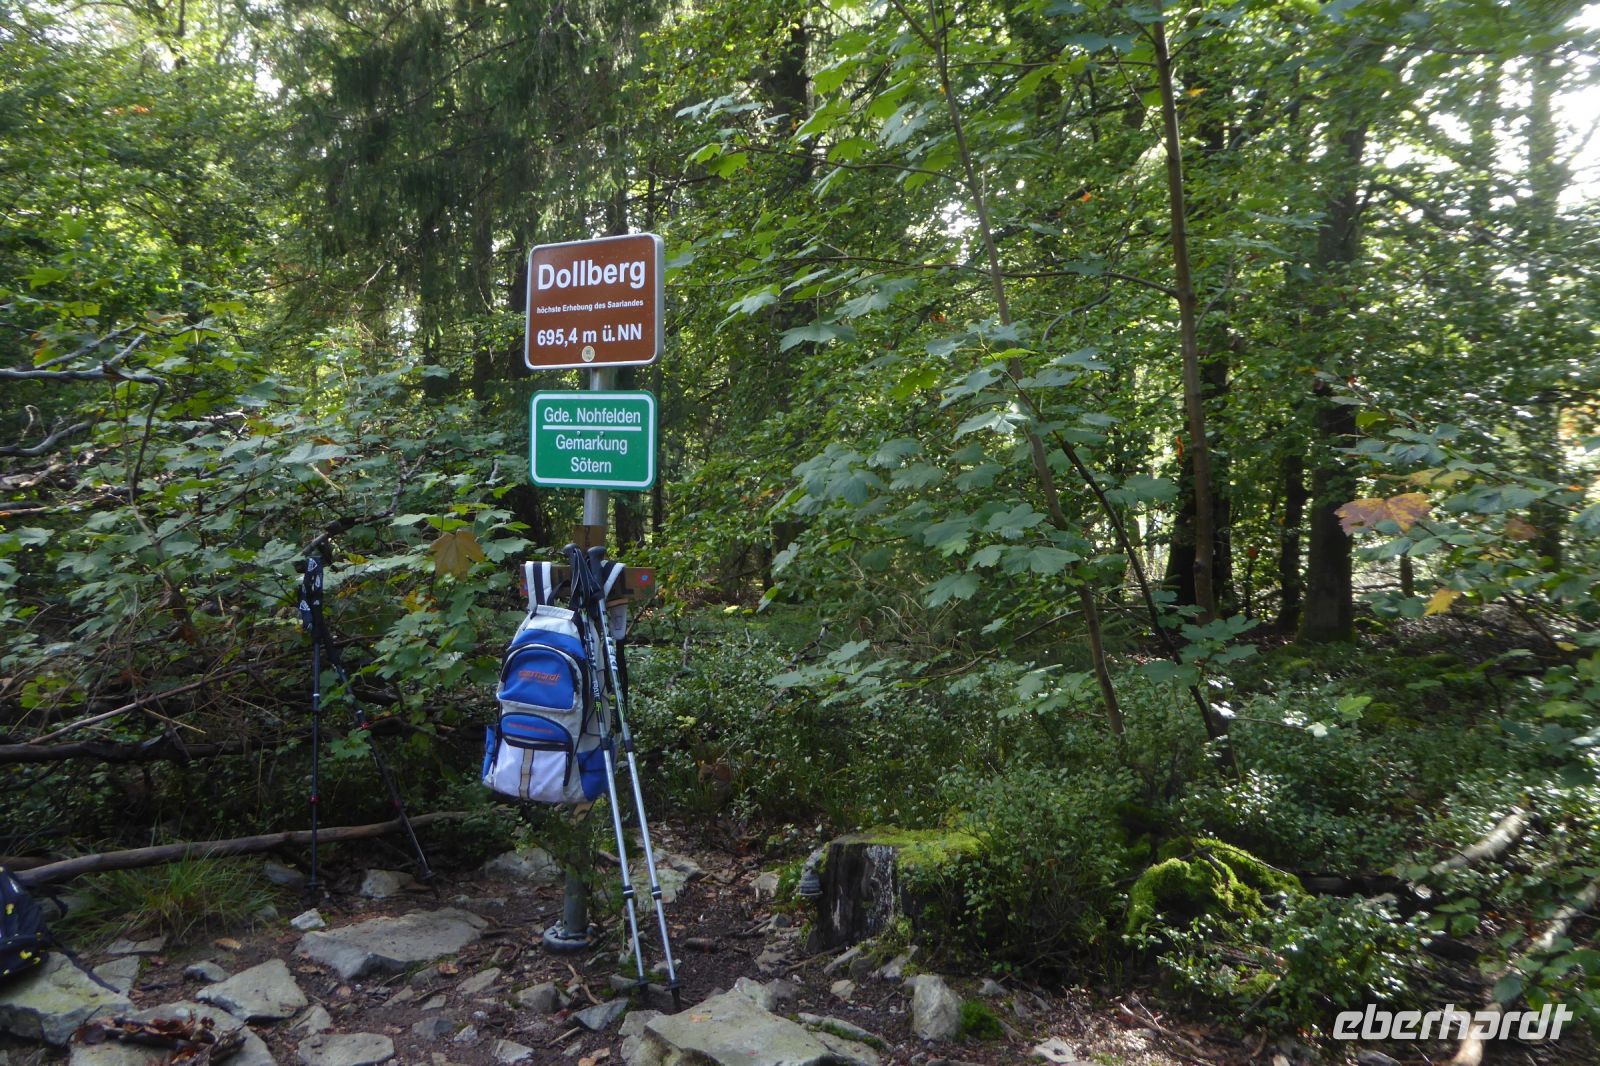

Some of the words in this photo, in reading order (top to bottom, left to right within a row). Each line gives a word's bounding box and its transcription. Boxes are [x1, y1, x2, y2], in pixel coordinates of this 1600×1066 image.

[538, 259, 646, 290] Dollberg
[537, 305, 562, 314] höchste
[562, 303, 593, 312] Erhebung
[594, 302, 606, 310] des
[607, 299, 644, 309] Saarlandes
[537, 327, 578, 348] 695,4
[583, 330, 597, 343] m
[544, 406, 573, 423] Gde.
[576, 407, 641, 424] Nohfelden
[555, 434, 628, 455] Gemarkung
[570, 456, 612, 473] Sötern
